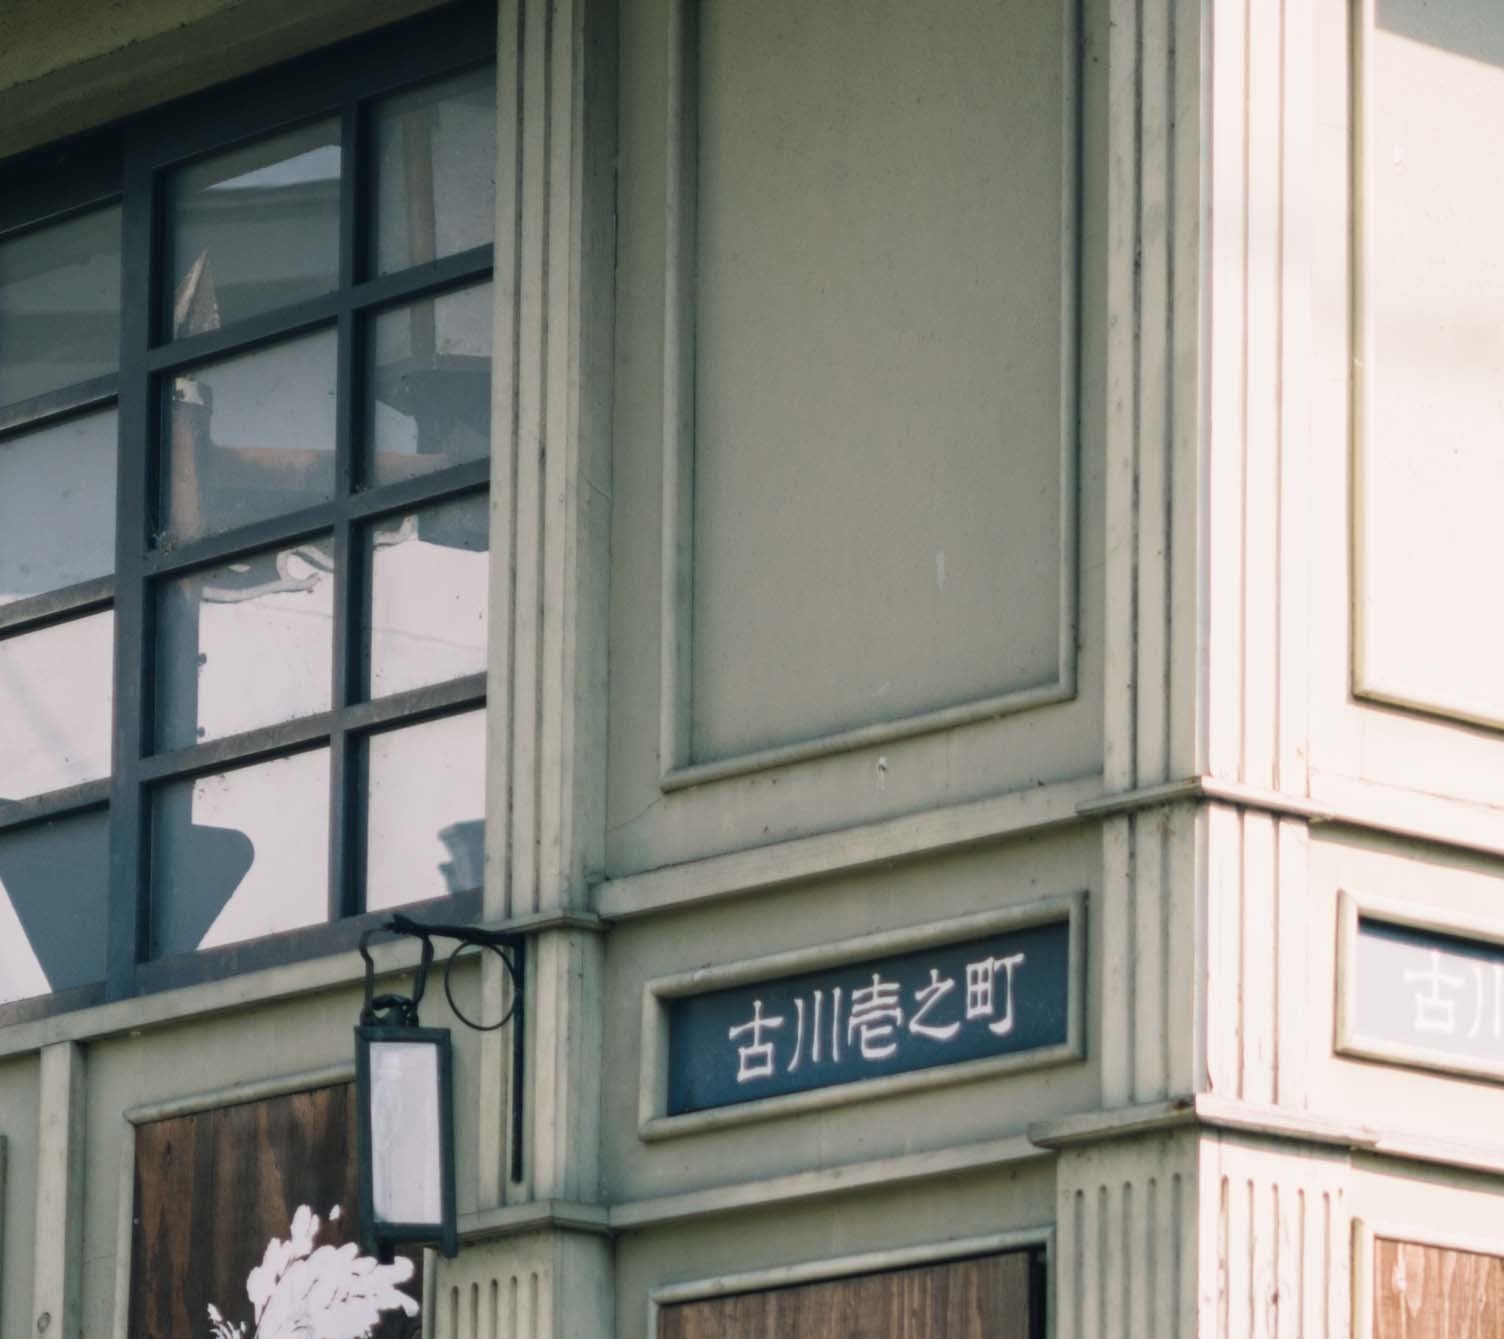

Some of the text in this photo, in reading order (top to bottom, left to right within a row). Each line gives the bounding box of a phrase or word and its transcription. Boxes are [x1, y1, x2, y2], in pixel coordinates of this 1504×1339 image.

[728, 952, 1026, 1082] 古川壱之町
